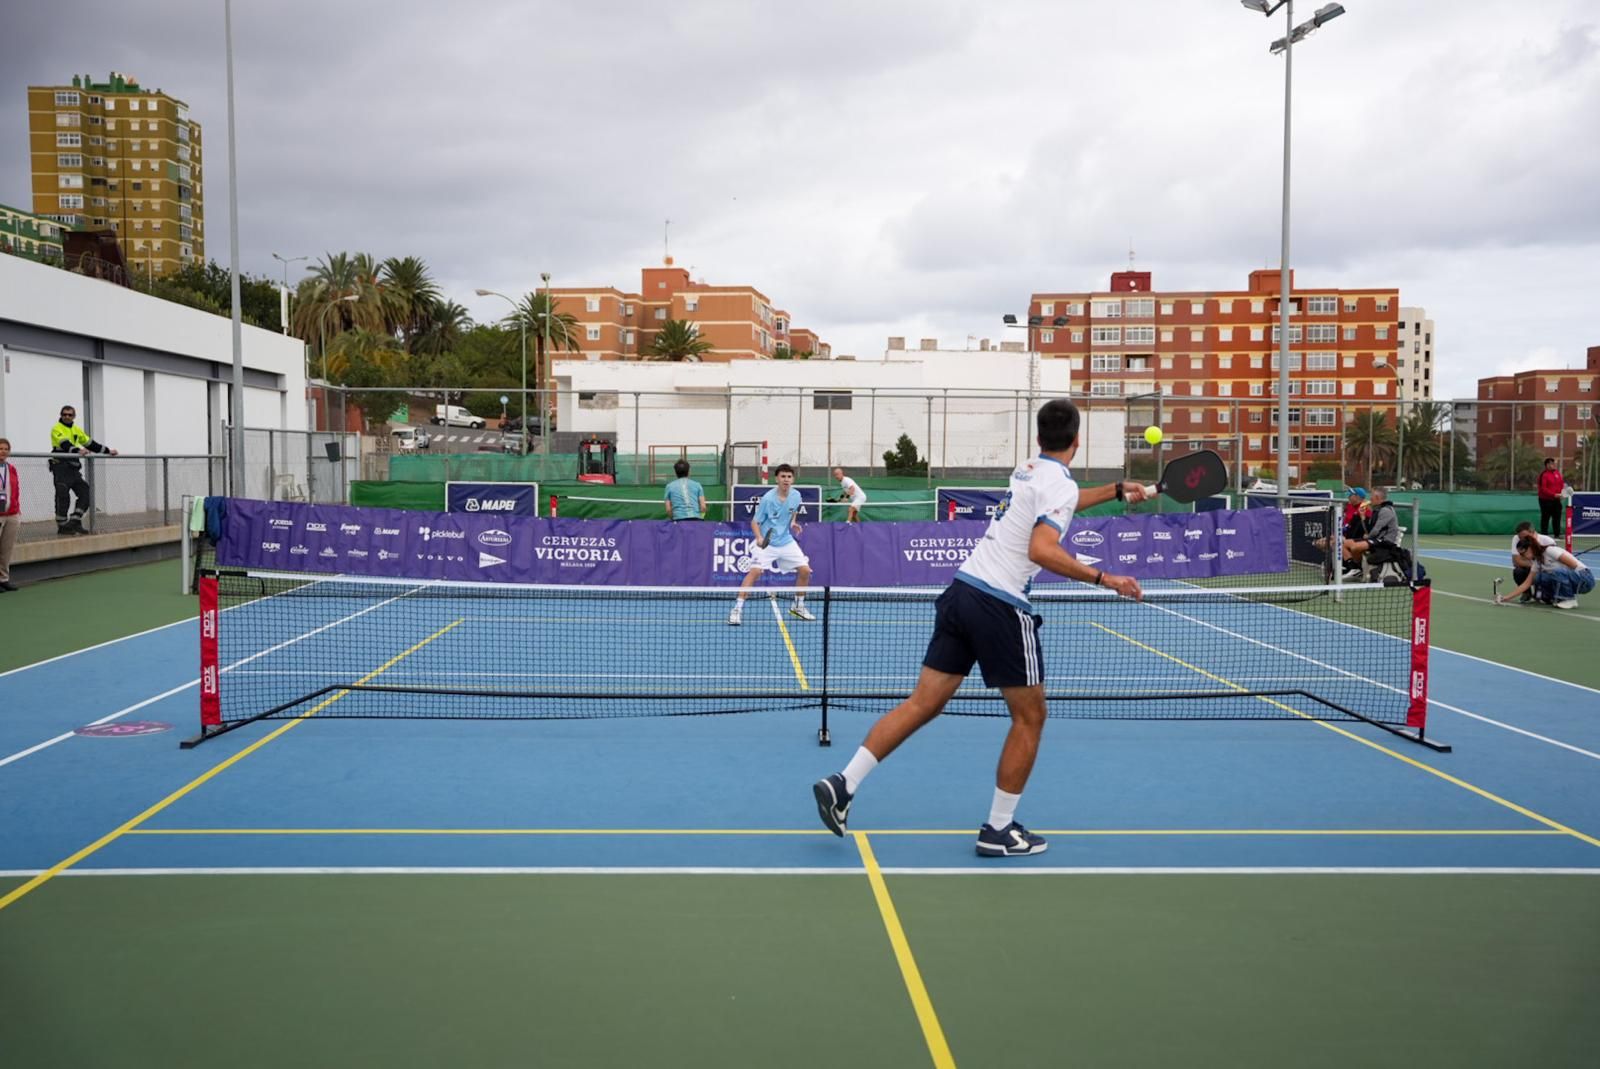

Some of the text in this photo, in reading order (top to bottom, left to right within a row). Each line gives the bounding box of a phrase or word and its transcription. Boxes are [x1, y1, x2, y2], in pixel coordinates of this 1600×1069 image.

[481, 499, 516, 511] MAPEI
[542, 536, 616, 547] CERVEZAS
[910, 538, 981, 548] CERVEZAS
[534, 547, 622, 561] VICTORIA
[903, 549, 973, 561] VICTOR
